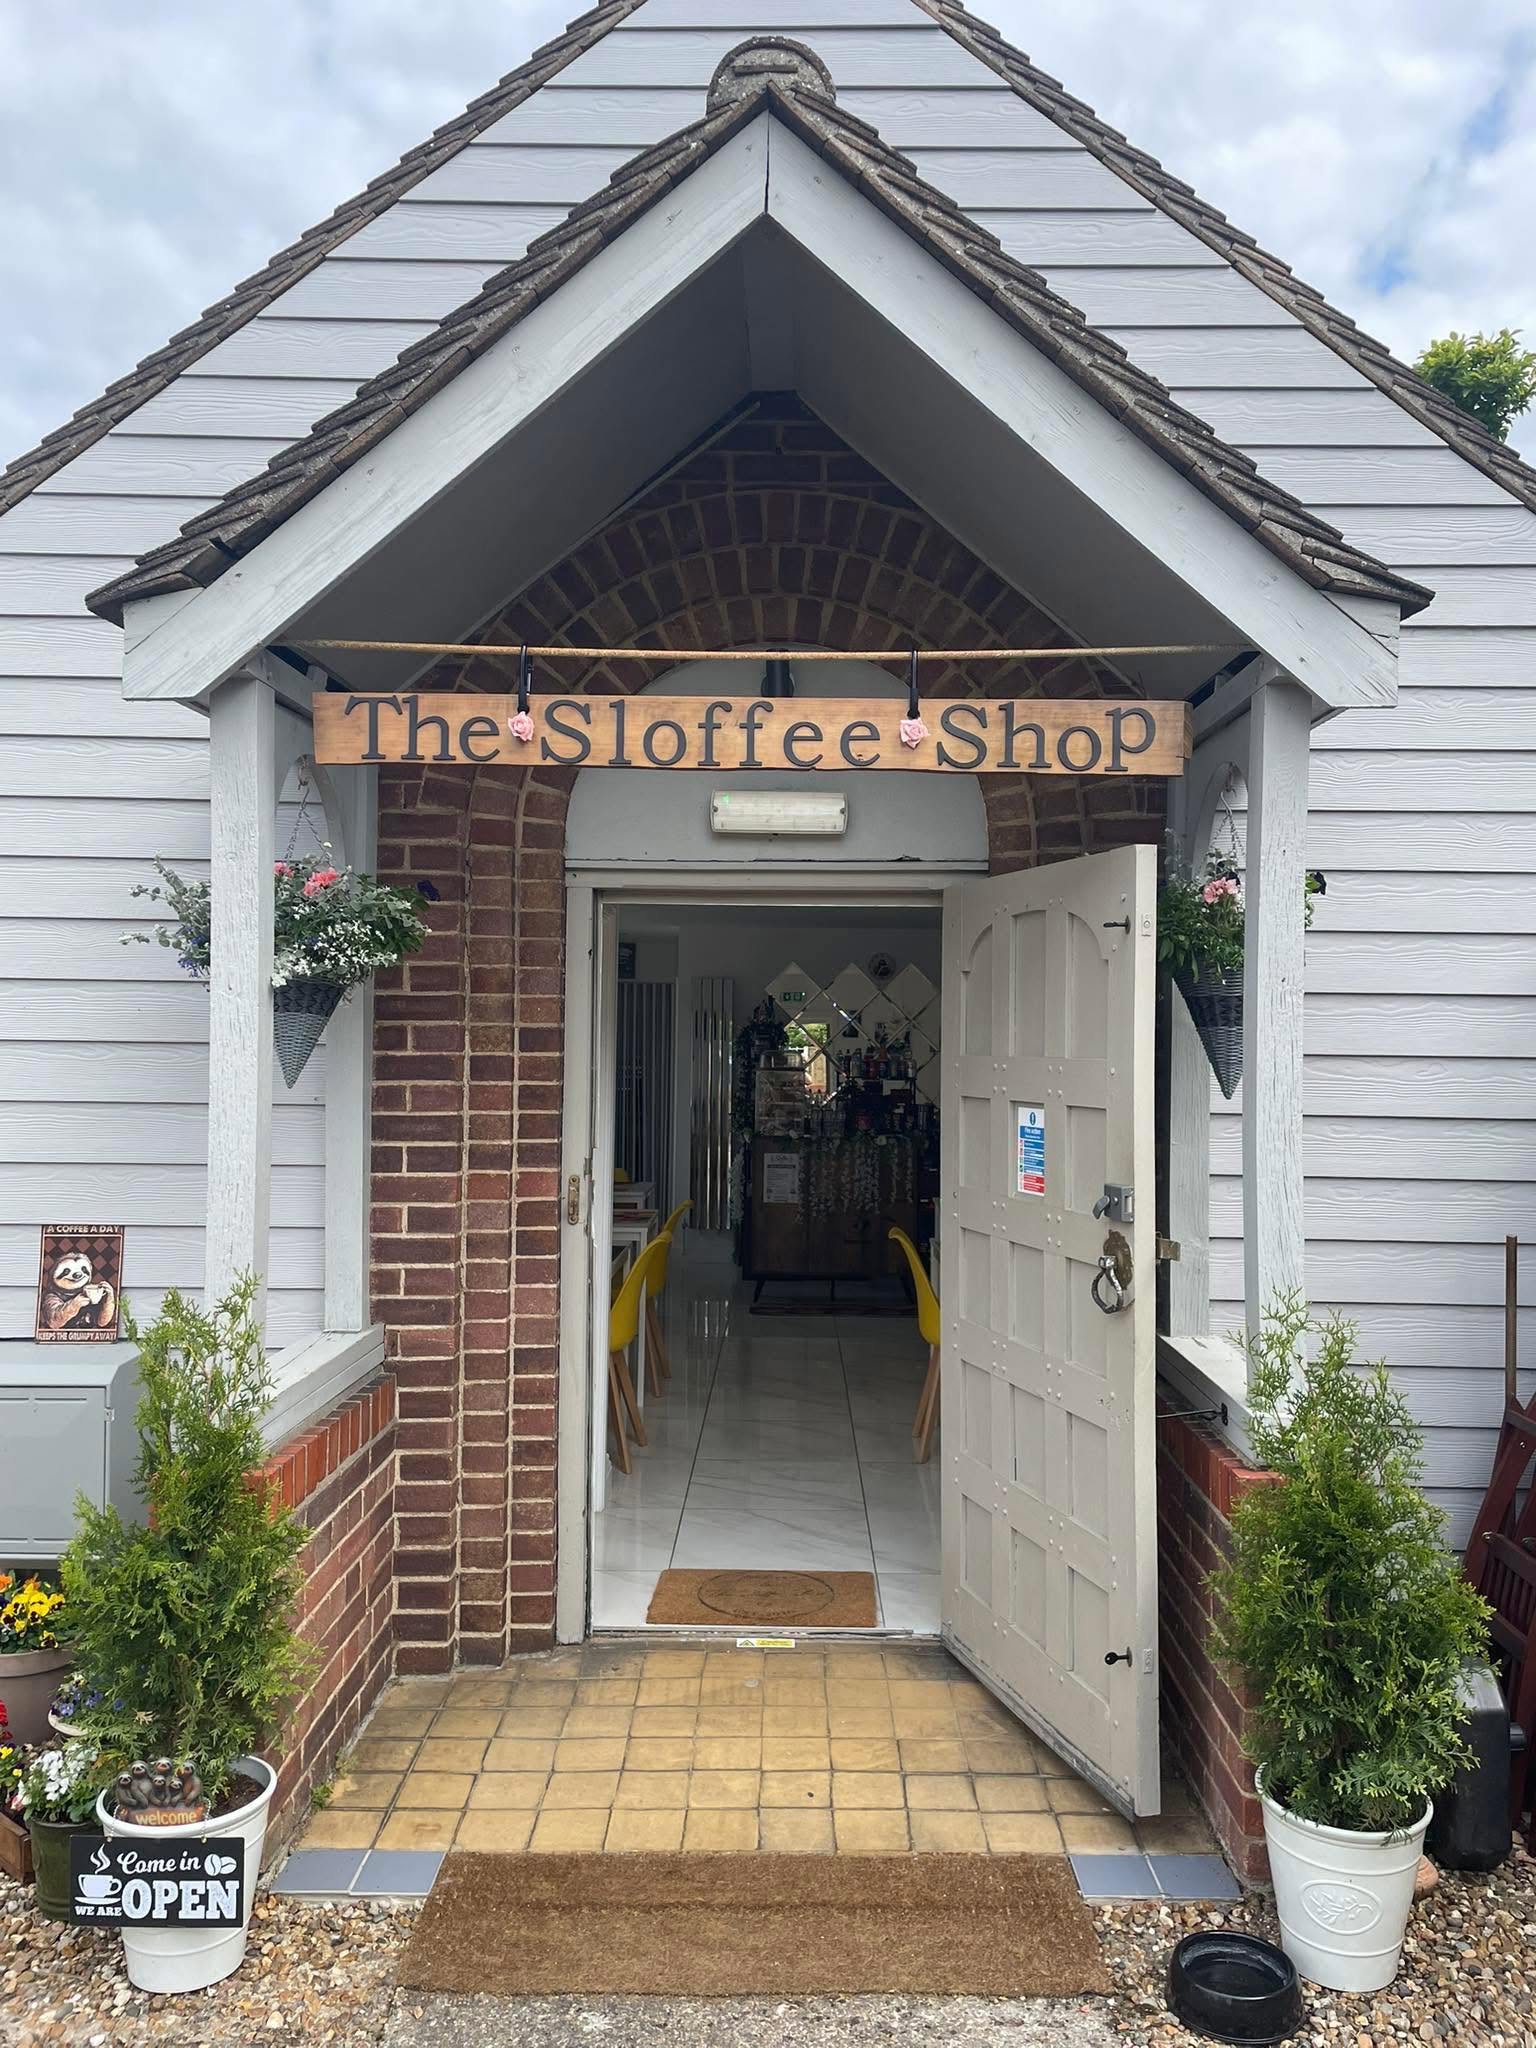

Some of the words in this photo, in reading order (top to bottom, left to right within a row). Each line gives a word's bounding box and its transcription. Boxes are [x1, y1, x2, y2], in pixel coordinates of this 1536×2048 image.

[344, 694, 500, 762] The
[541, 698, 881, 767] Sloffee
[937, 701, 1156, 772] Shop
[46, 1225, 54, 1233] A
[56, 1225, 88, 1233] COFFEE
[90, 1225, 98, 1233] A
[99, 1225, 120, 1233] DAY
[39, 1331, 56, 1340] KEEPS
[56, 1331, 68, 1340] THE
[135, 1810, 198, 1825] welcome
[116, 1851, 177, 1875] Come
[179, 1851, 201, 1871] in
[75, 1906, 94, 1916] WE
[96, 1906, 122, 1917] ARE
[121, 1878, 239, 1919] OPEN
